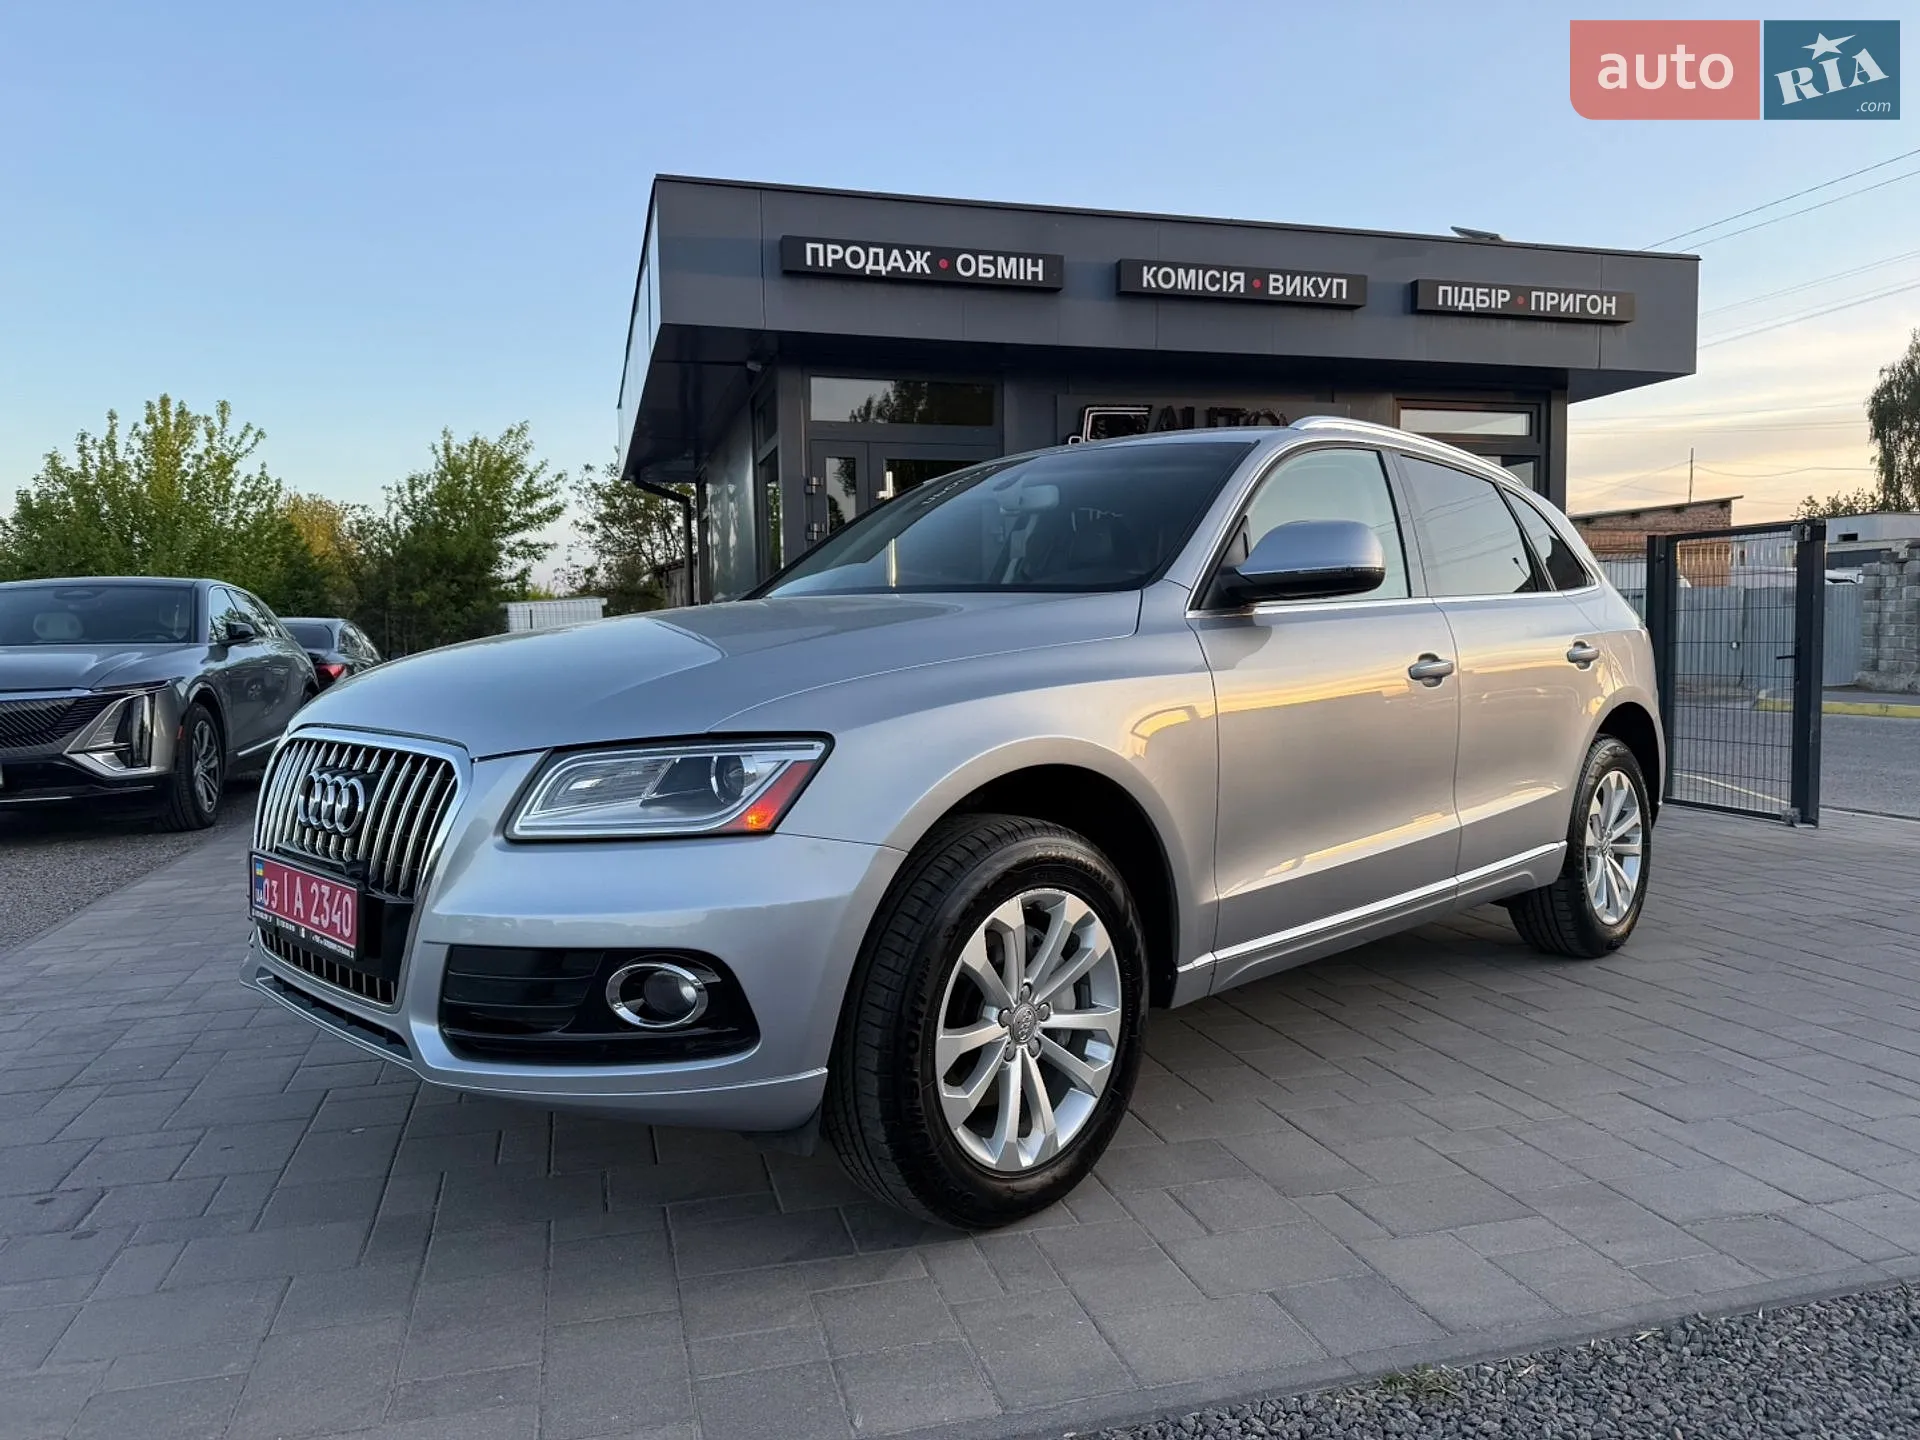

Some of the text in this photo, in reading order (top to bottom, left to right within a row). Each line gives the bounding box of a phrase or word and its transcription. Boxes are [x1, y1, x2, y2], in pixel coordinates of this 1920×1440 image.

[805, 242, 1044, 281] ПРОДАЖ ОБМІН
[1142, 265, 1348, 299] КОМІСІЯ ВИКУП
[1437, 285, 1616, 316] ПІДБІР ПРИГОН
[263, 879, 278, 909] 03
[311, 883, 352, 938] 2340
